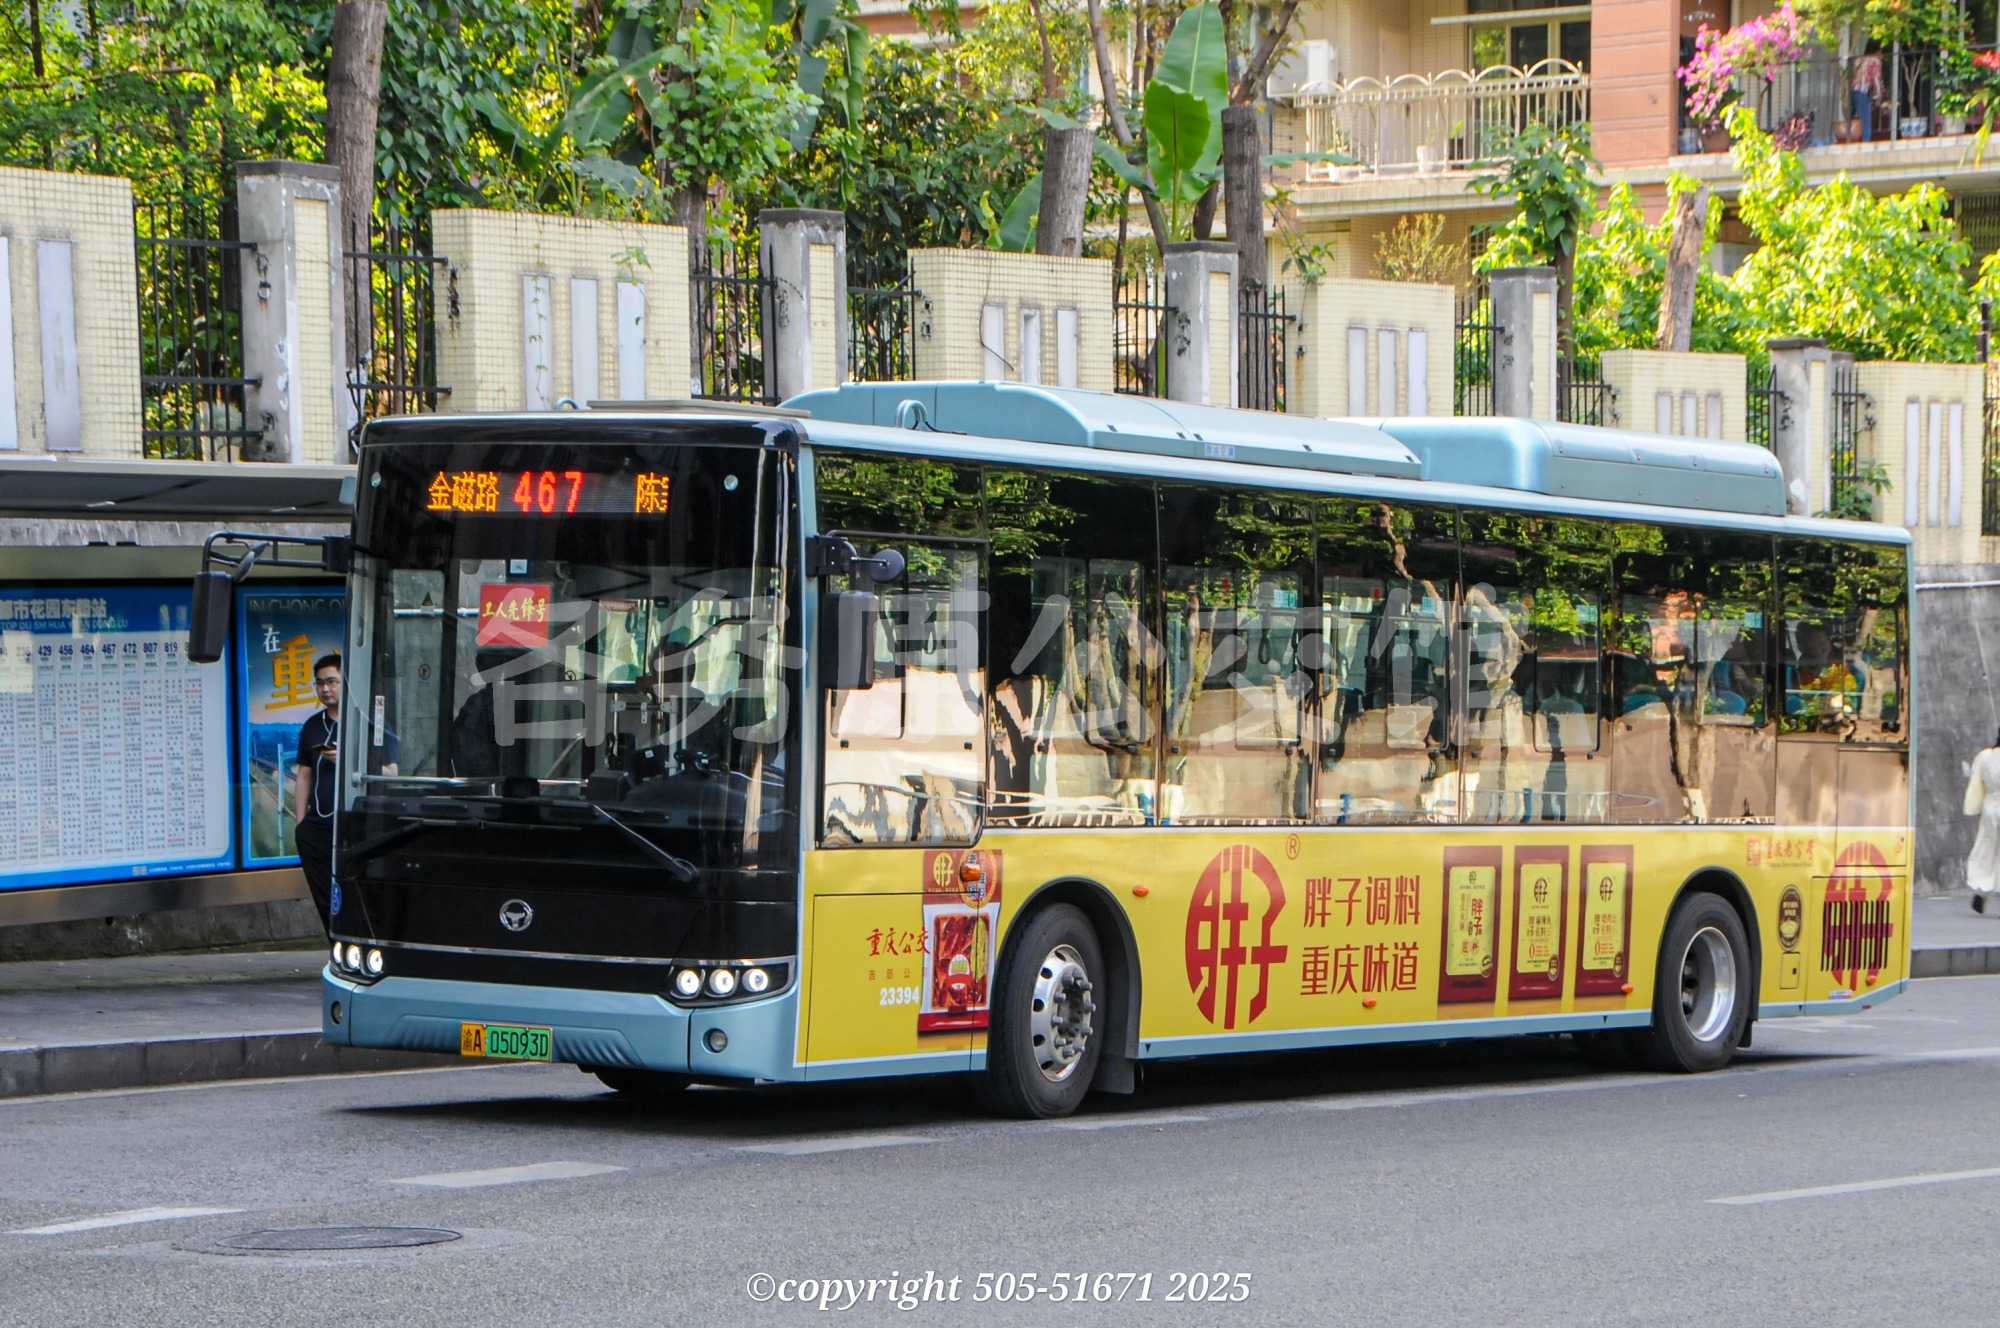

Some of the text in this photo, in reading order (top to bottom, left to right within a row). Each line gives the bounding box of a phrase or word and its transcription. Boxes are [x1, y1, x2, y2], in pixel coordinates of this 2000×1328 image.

[514, 470, 583, 514] 467
[482, 597, 547, 623] 工人先锋号
[38, 645, 52, 657] 429
[59, 644, 74, 656] 456
[81, 643, 95, 655] 464
[102, 643, 117, 655] 467
[123, 642, 137, 654] 472
[143, 642, 158, 653] 807
[164, 641, 178, 653] 819
[263, 627, 281, 654] 在
[1304, 875, 1420, 928] 胖子调料
[866, 926, 931, 957] 重庆公交
[1300, 941, 1419, 996] 重庆味道
[880, 986, 920, 1006] 23394
